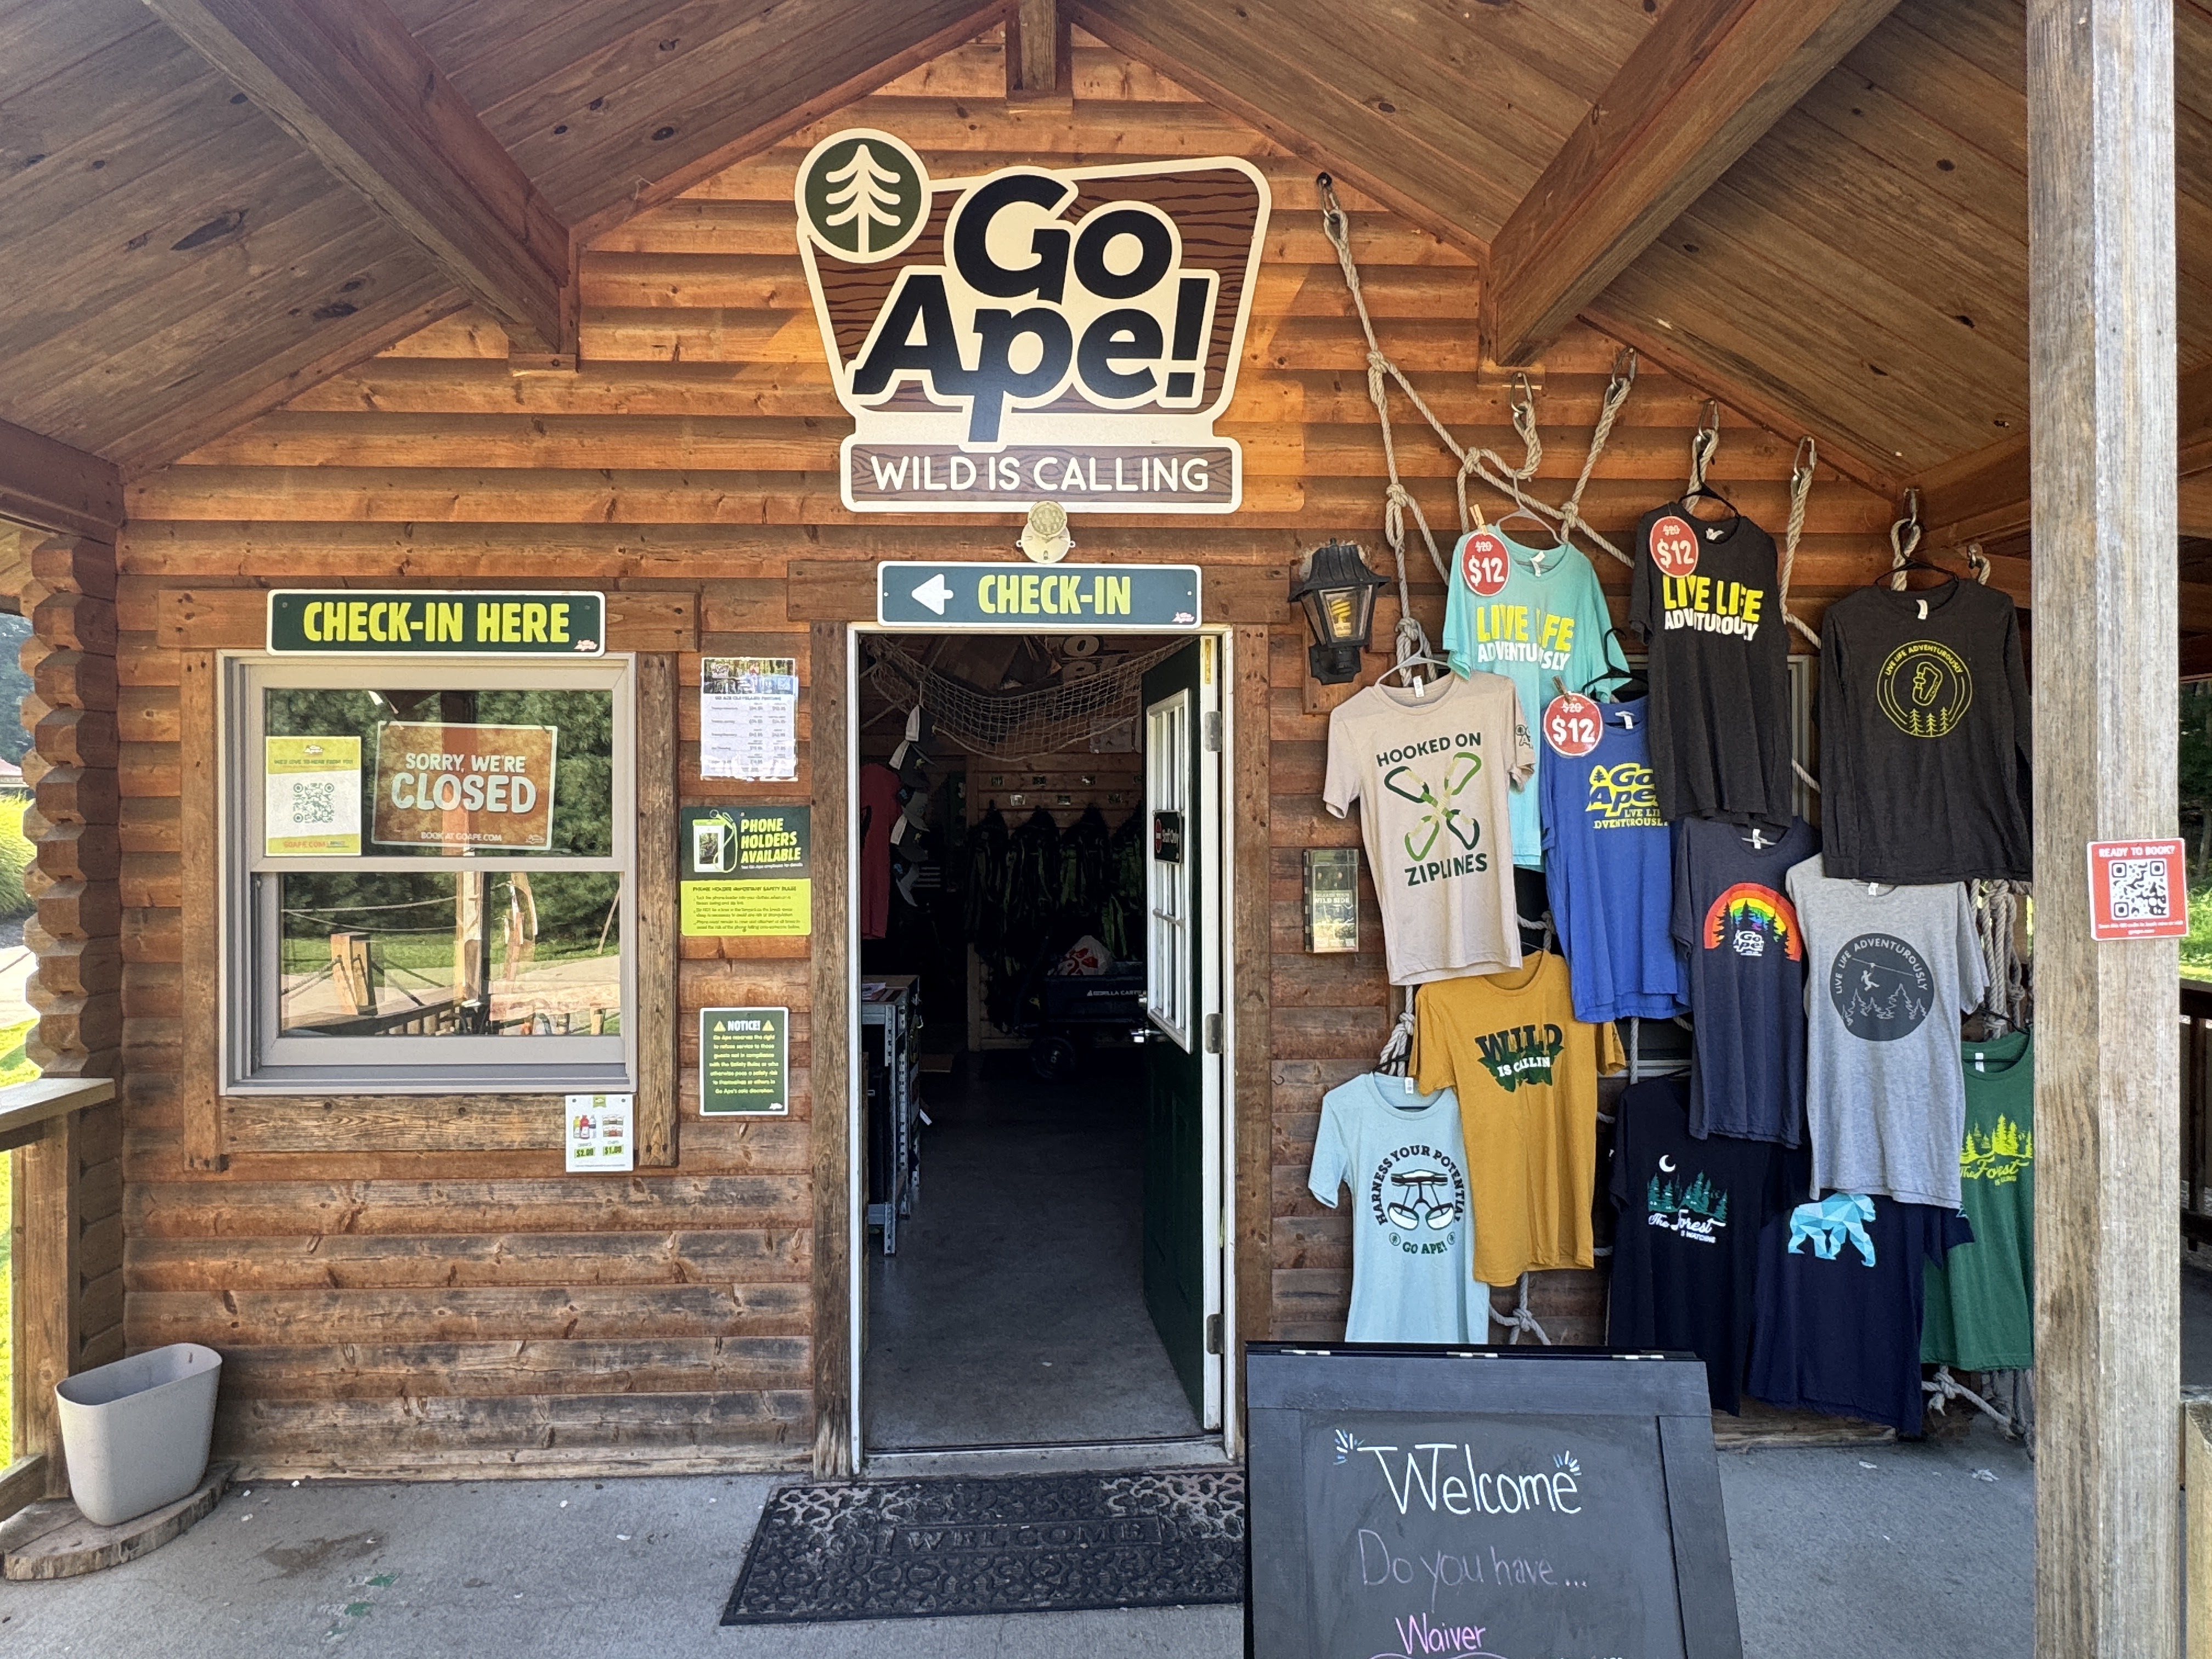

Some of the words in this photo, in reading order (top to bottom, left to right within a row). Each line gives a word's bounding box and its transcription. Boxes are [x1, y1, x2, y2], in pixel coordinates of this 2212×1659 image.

[953, 174, 1172, 306] Go
[851, 274, 1210, 442] Ape!
[871, 456, 978, 492] WILD
[989, 456, 1020, 491] IS
[1034, 456, 1209, 492] CALLING
[1657, 538, 1694, 568] $12
[1468, 555, 1505, 586] $12
[978, 574, 1131, 614] CHECK-IN
[303, 601, 464, 642] CHECK-IN
[477, 602, 569, 643] HERE
[1477, 603, 1528, 642] LIVE
[1884, 660, 1896, 676] LIVE
[1894, 650, 1907, 662] LIFE
[1908, 644, 1963, 674] ADVENTUROUSLY
[1551, 715, 1595, 746] $12
[405, 753, 464, 773] SORRY,
[471, 755, 526, 772] WE'RE
[1376, 737, 1451, 767] HOOKED
[1455, 732, 1481, 747] ON
[391, 772, 537, 814] CLOSED
[741, 818, 784, 833] PHONE
[741, 832, 798, 849] HOLDERS
[741, 848, 802, 864] AVAILABLE
[2098, 847, 2128, 857] READY
[2130, 847, 2143, 856] TO
[2145, 845, 2175, 855] BOOK?
[1404, 853, 1487, 886] ZIPLINES
[1740, 931, 1762, 943] Go
[1838, 950, 1852, 968] LIFE
[1854, 938, 1928, 991] ADVENTUROUSLY
[727, 1020, 761, 1031] NOTICE!
[1475, 1024, 1562, 1062] WILD
[1497, 1065, 1512, 1077] IS
[1372, 1158, 1393, 1226] HARNESS
[1390, 1144, 1430, 1161] YOUR
[1403, 1241, 1418, 1254] GO
[1421, 1241, 1447, 1255] APE!
[1357, 1443, 1582, 1515] Welcome
[1358, 1528, 1414, 1586] Do
[1419, 1549, 1482, 1613] you
[1395, 1613, 1487, 1656] Waiver
